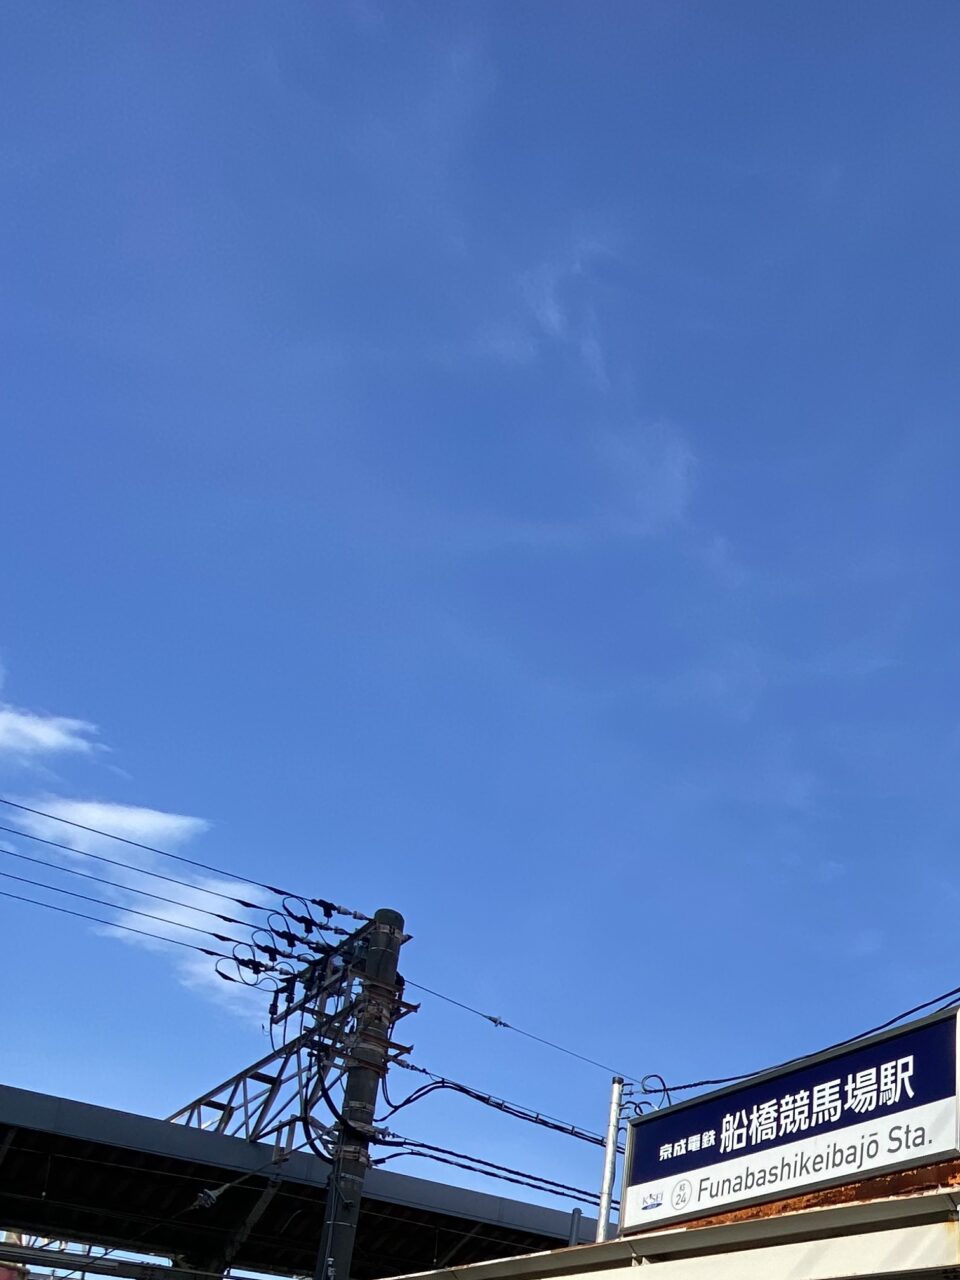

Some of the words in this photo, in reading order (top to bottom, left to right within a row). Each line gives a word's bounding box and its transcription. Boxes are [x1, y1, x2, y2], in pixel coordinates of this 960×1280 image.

[659, 1130, 716, 1161] 京成電鉄
[719, 1055, 915, 1154] 船橋競馬場駅
[675, 1192, 687, 1206] 24
[698, 1132, 879, 1202] Funabashikeibajō
[887, 1123, 933, 1154] Sta.
